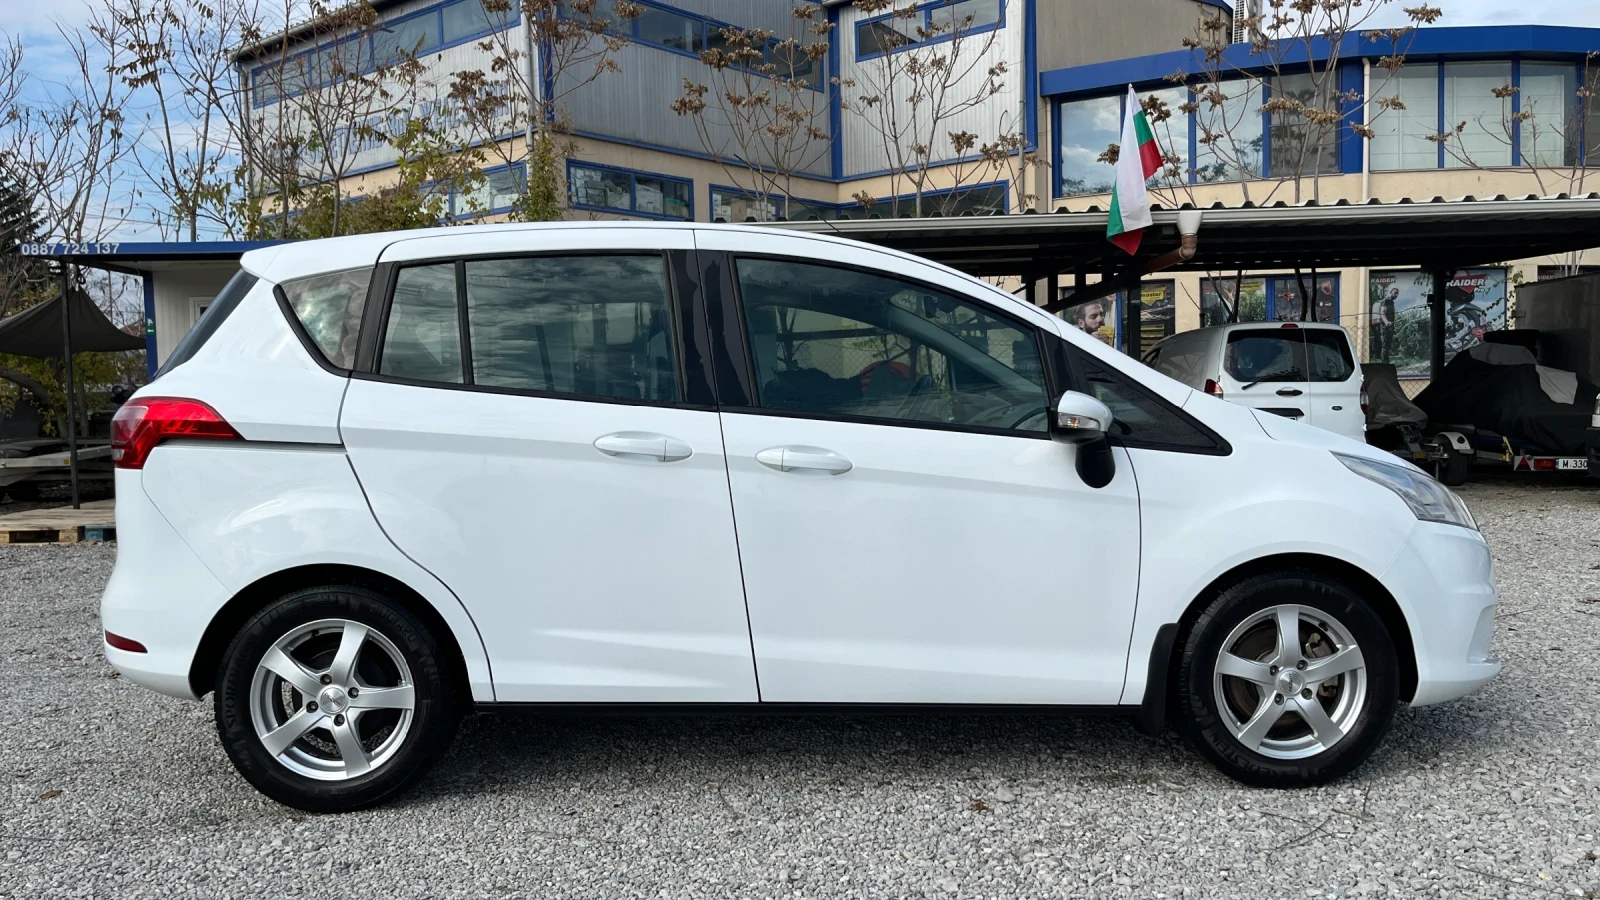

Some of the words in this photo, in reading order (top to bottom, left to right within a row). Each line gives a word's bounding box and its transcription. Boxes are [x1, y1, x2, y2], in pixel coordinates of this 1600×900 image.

[22, 243, 57, 255] 0887
[62, 243, 89, 255] 724
[95, 242, 120, 254] 137
[1446, 278, 1485, 287] RAIDER
[1562, 460, 1569, 468] M
[1572, 460, 1588, 468] 330
